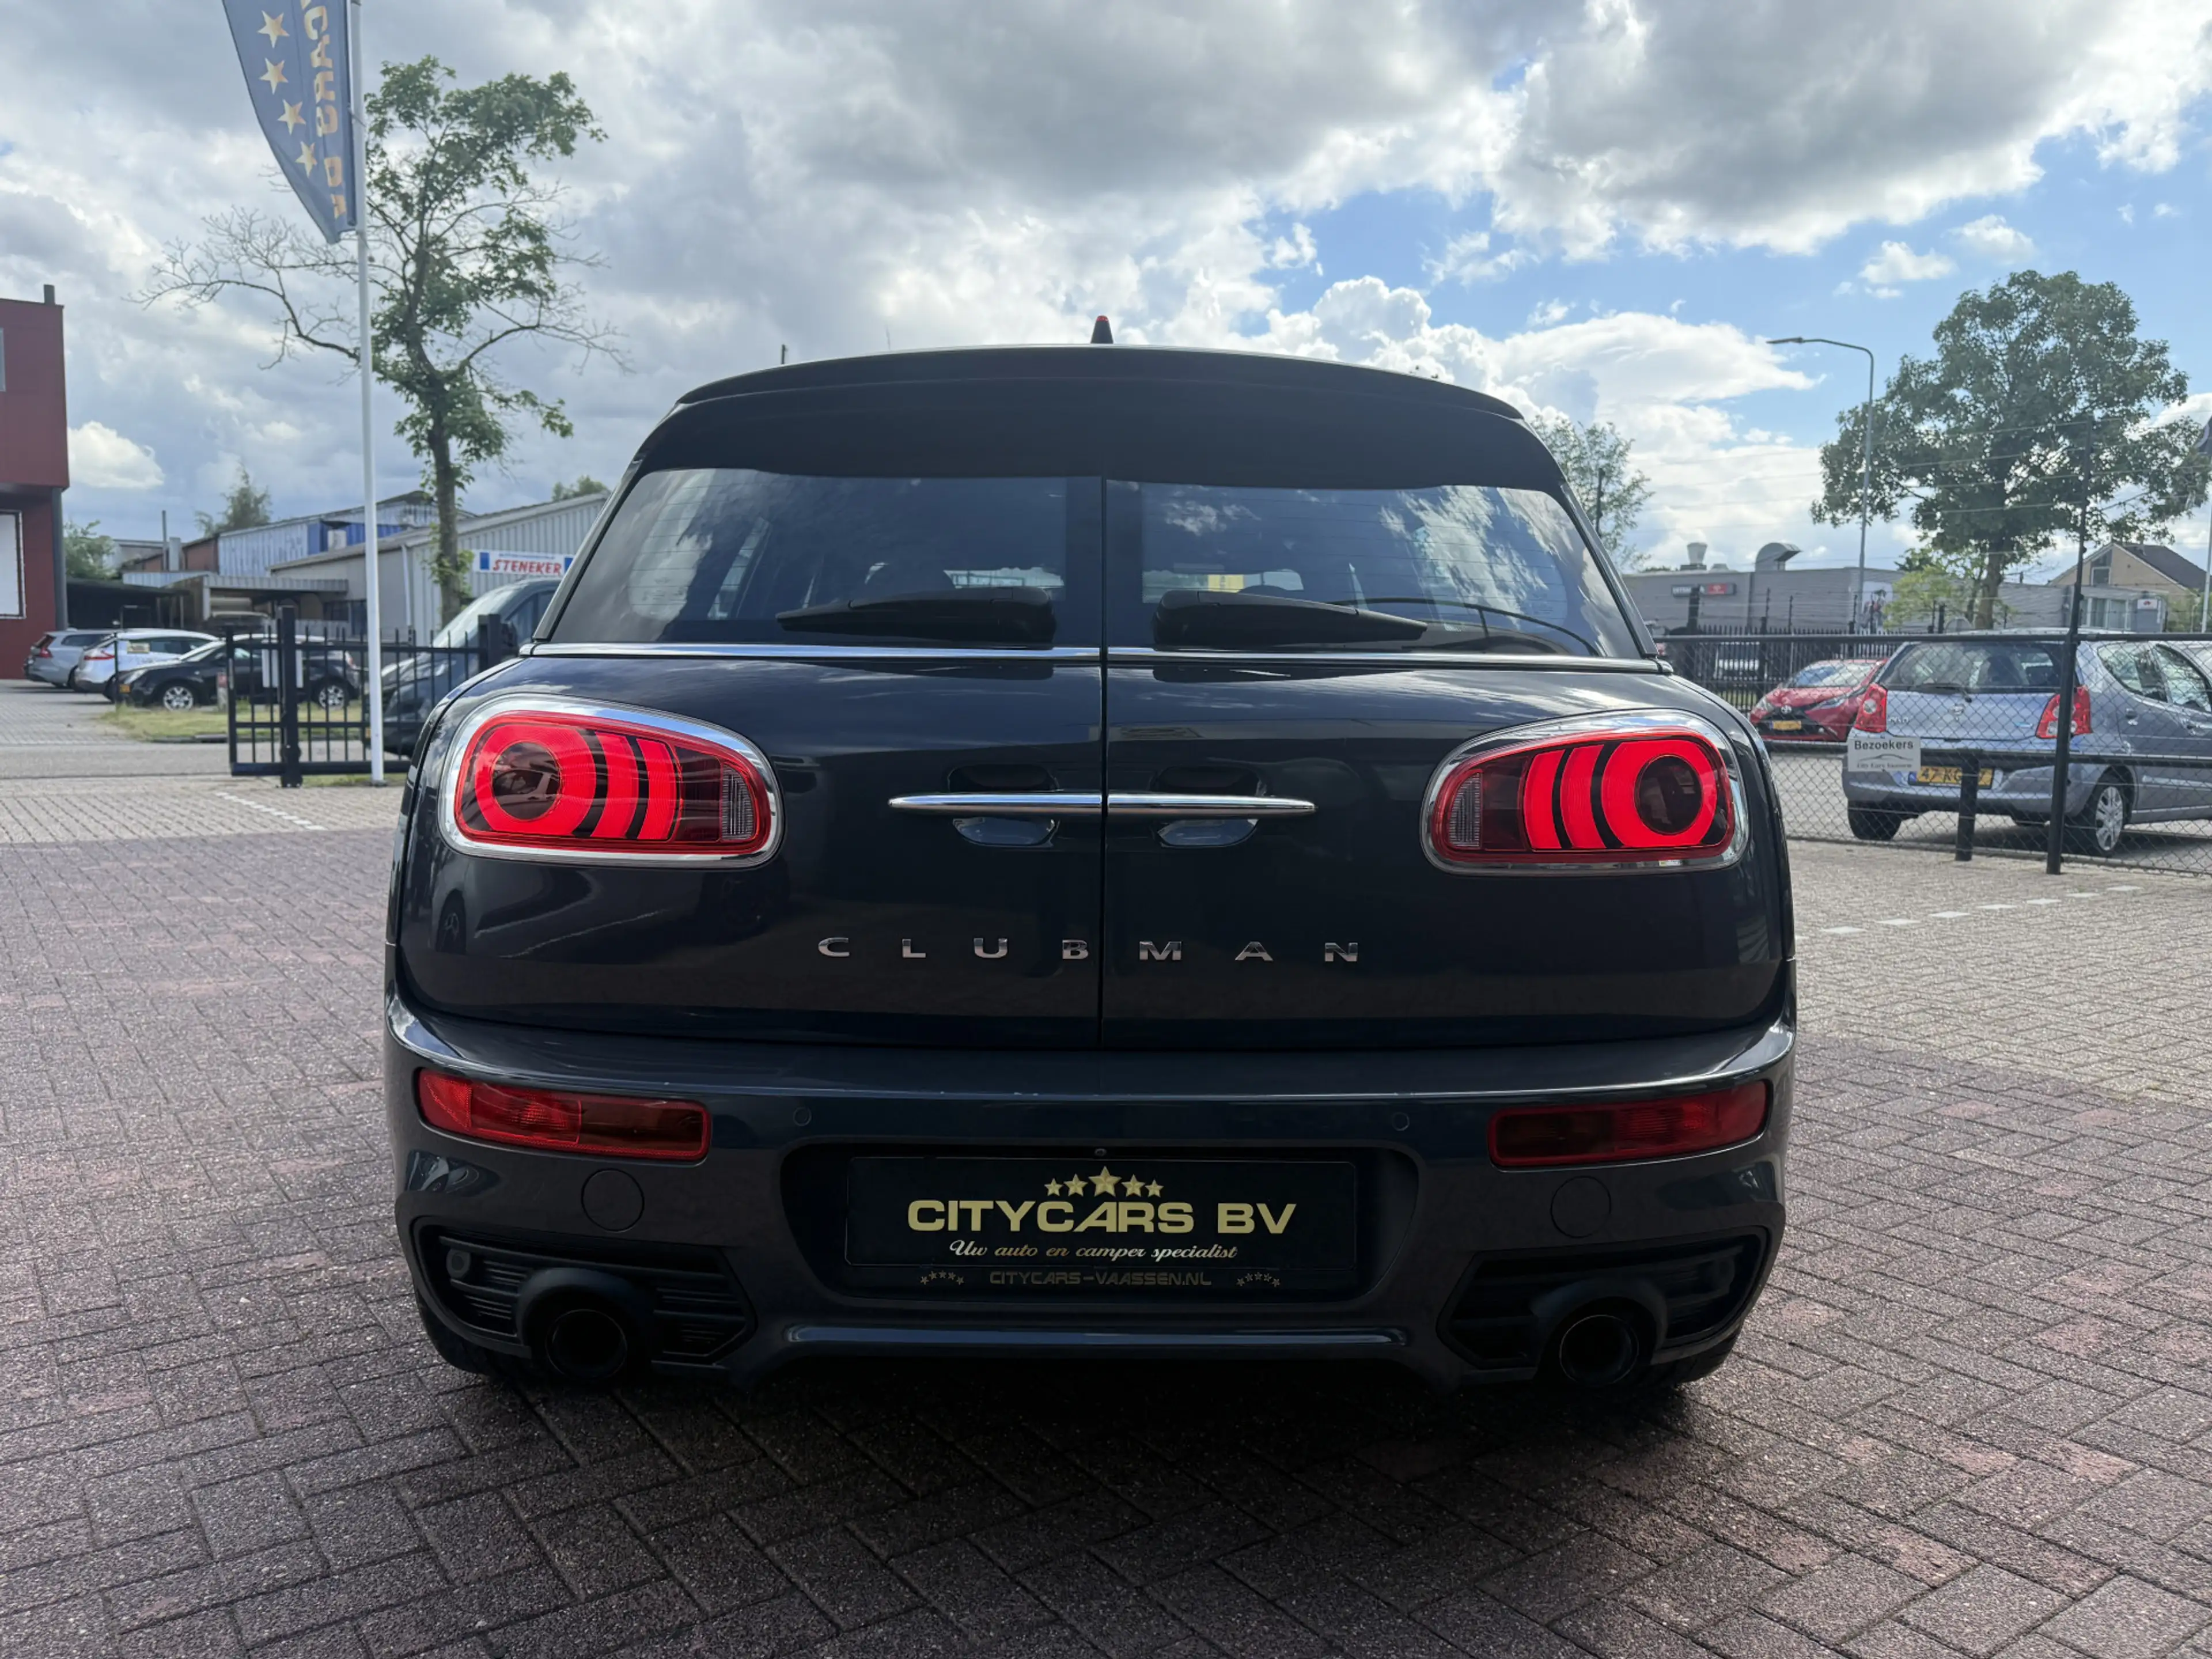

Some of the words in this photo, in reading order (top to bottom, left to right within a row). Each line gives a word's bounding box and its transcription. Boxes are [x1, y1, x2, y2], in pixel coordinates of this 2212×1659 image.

[493, 559, 562, 576] STENEKER
[1854, 740, 1914, 750] Bezoekers
[817, 937, 1358, 962] CLUBMAN
[907, 1199, 1195, 1234] CITYCARS
[1217, 1202, 1297, 1234] BV
[949, 1239, 988, 1256] Uw
[994, 1243, 1038, 1257] auto
[1046, 1247, 1070, 1257] en
[1075, 1247, 1147, 1262] camper
[1150, 1243, 1238, 1262] specialist
[989, 1271, 1212, 1286] CITYCARS-VAASSEN.NL
